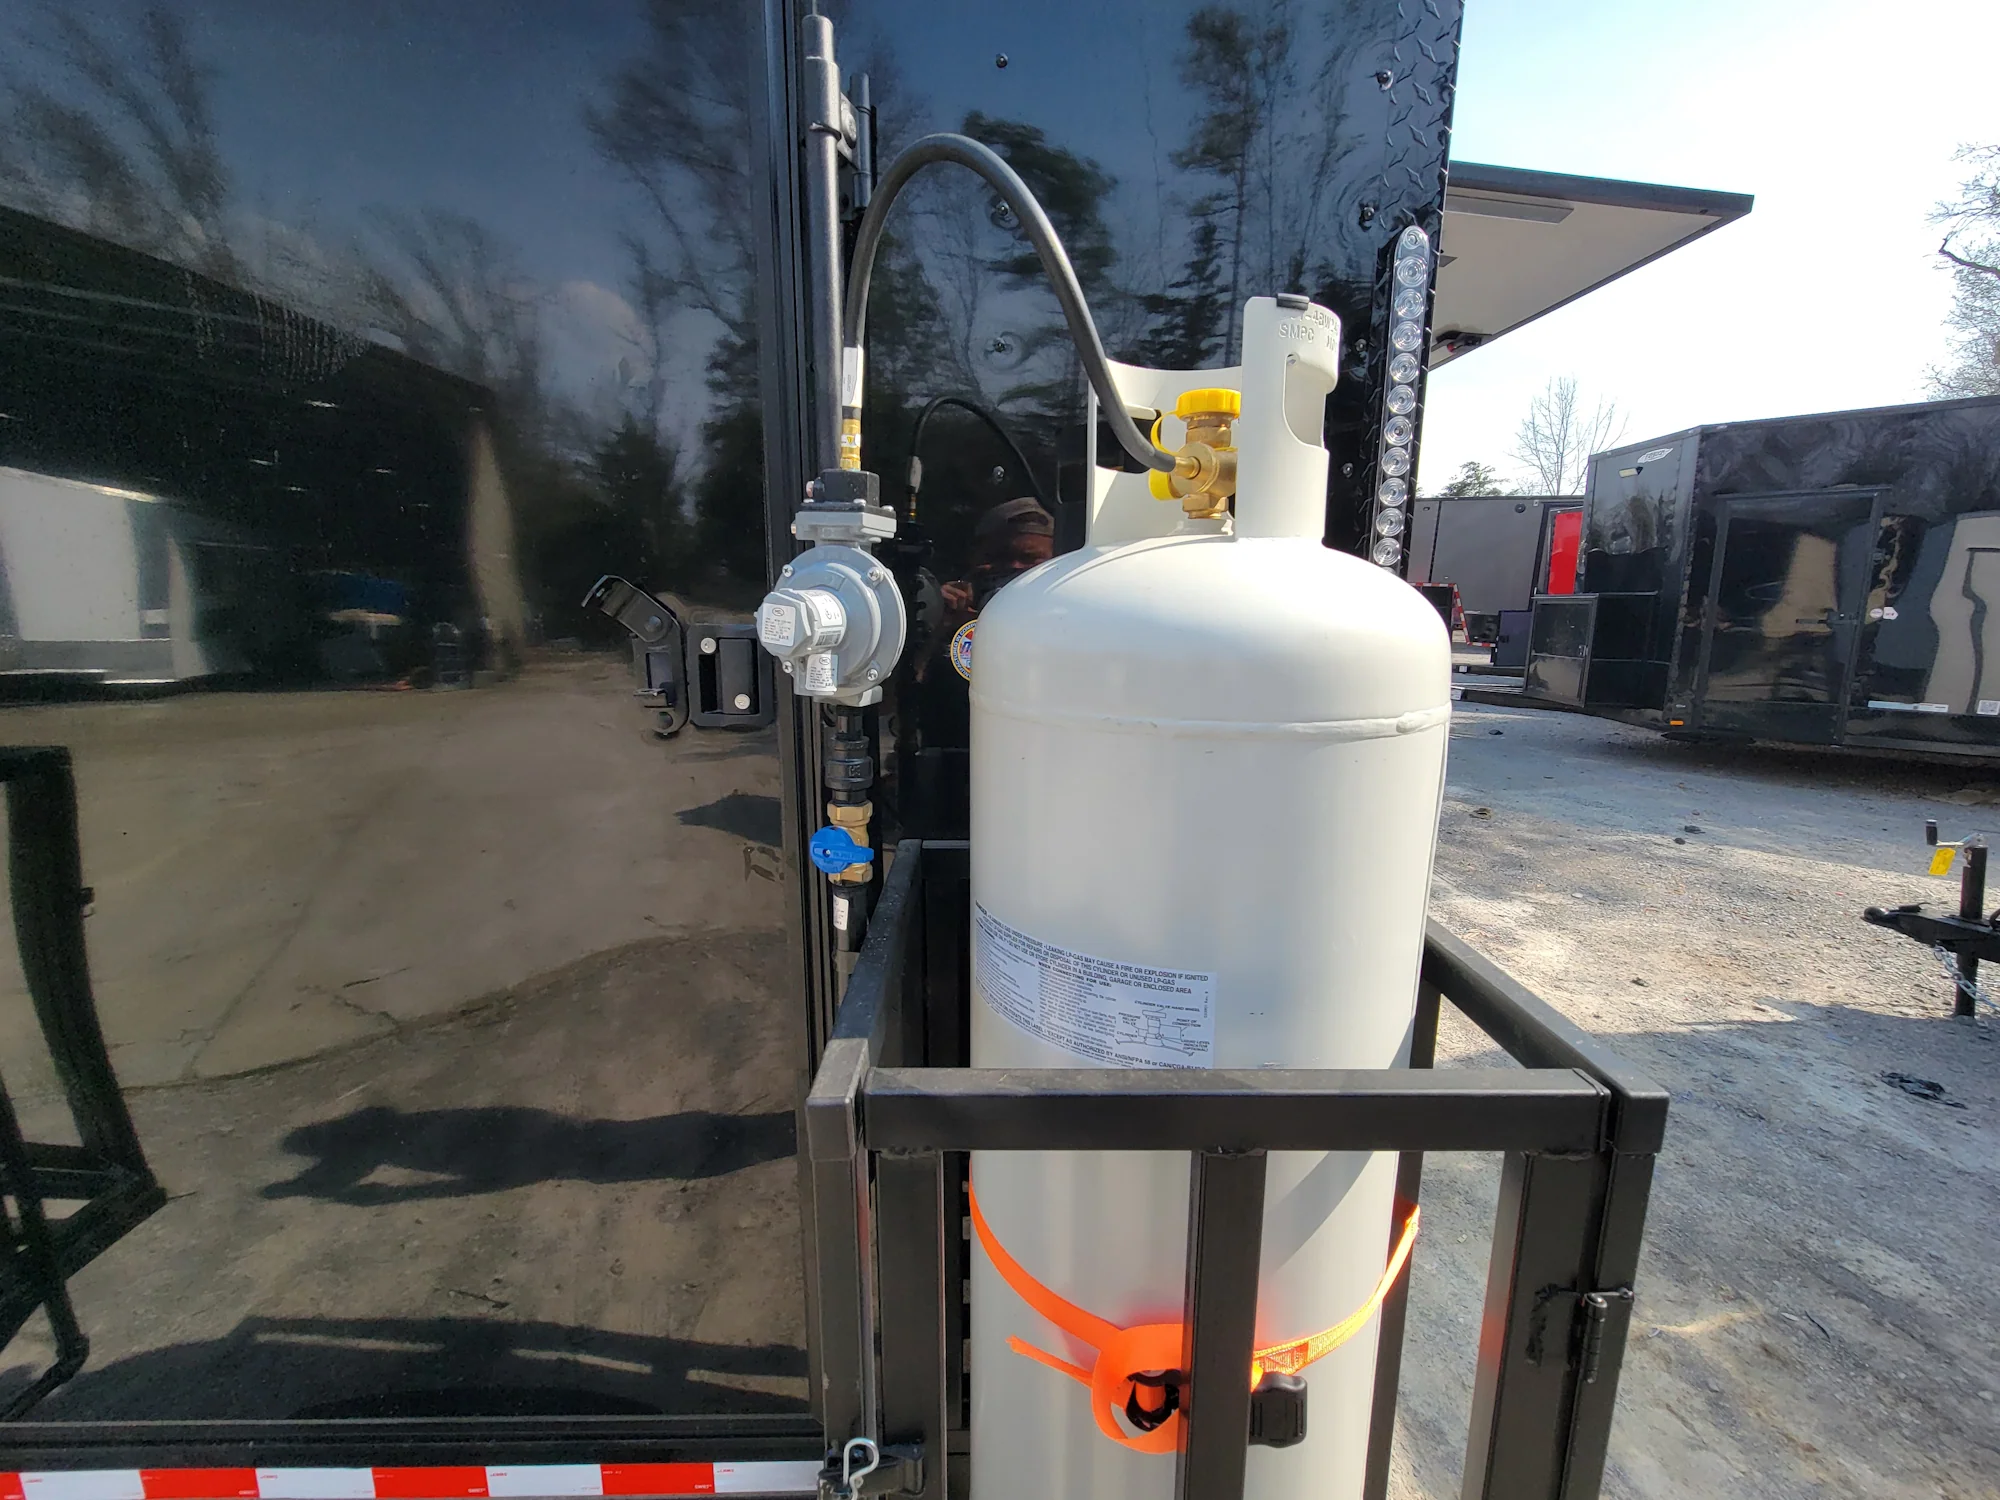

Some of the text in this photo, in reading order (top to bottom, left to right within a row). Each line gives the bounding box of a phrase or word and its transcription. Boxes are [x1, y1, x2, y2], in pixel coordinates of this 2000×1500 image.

[1279, 324, 1315, 343] SMPC
[1023, 935, 1043, 948] PRESSURE
[1066, 951, 1083, 961] LP-GAS
[1084, 956, 1095, 964] MAY
[1096, 960, 1114, 969] CAUSE
[1144, 969, 1176, 978] EXPLOSION
[1026, 944, 1042, 954] REPAIRS
[1050, 953, 1072, 964] DISPOSAL
[1081, 962, 1091, 970] THIS
[1093, 965, 1118, 976] CYLINDER
[1129, 974, 1152, 982] UNUSED
[1038, 961, 1051, 969] WHEN
[1053, 967, 1084, 980] CONNECTING
[1035, 954, 1049, 963] STORE
[1049, 959, 1071, 971] CYLINDER
[1109, 977, 1132, 986] GARAGE
[1143, 983, 1174, 992] ENCLOSED
[1074, 1041, 1105, 1055] AUTHORIZED
